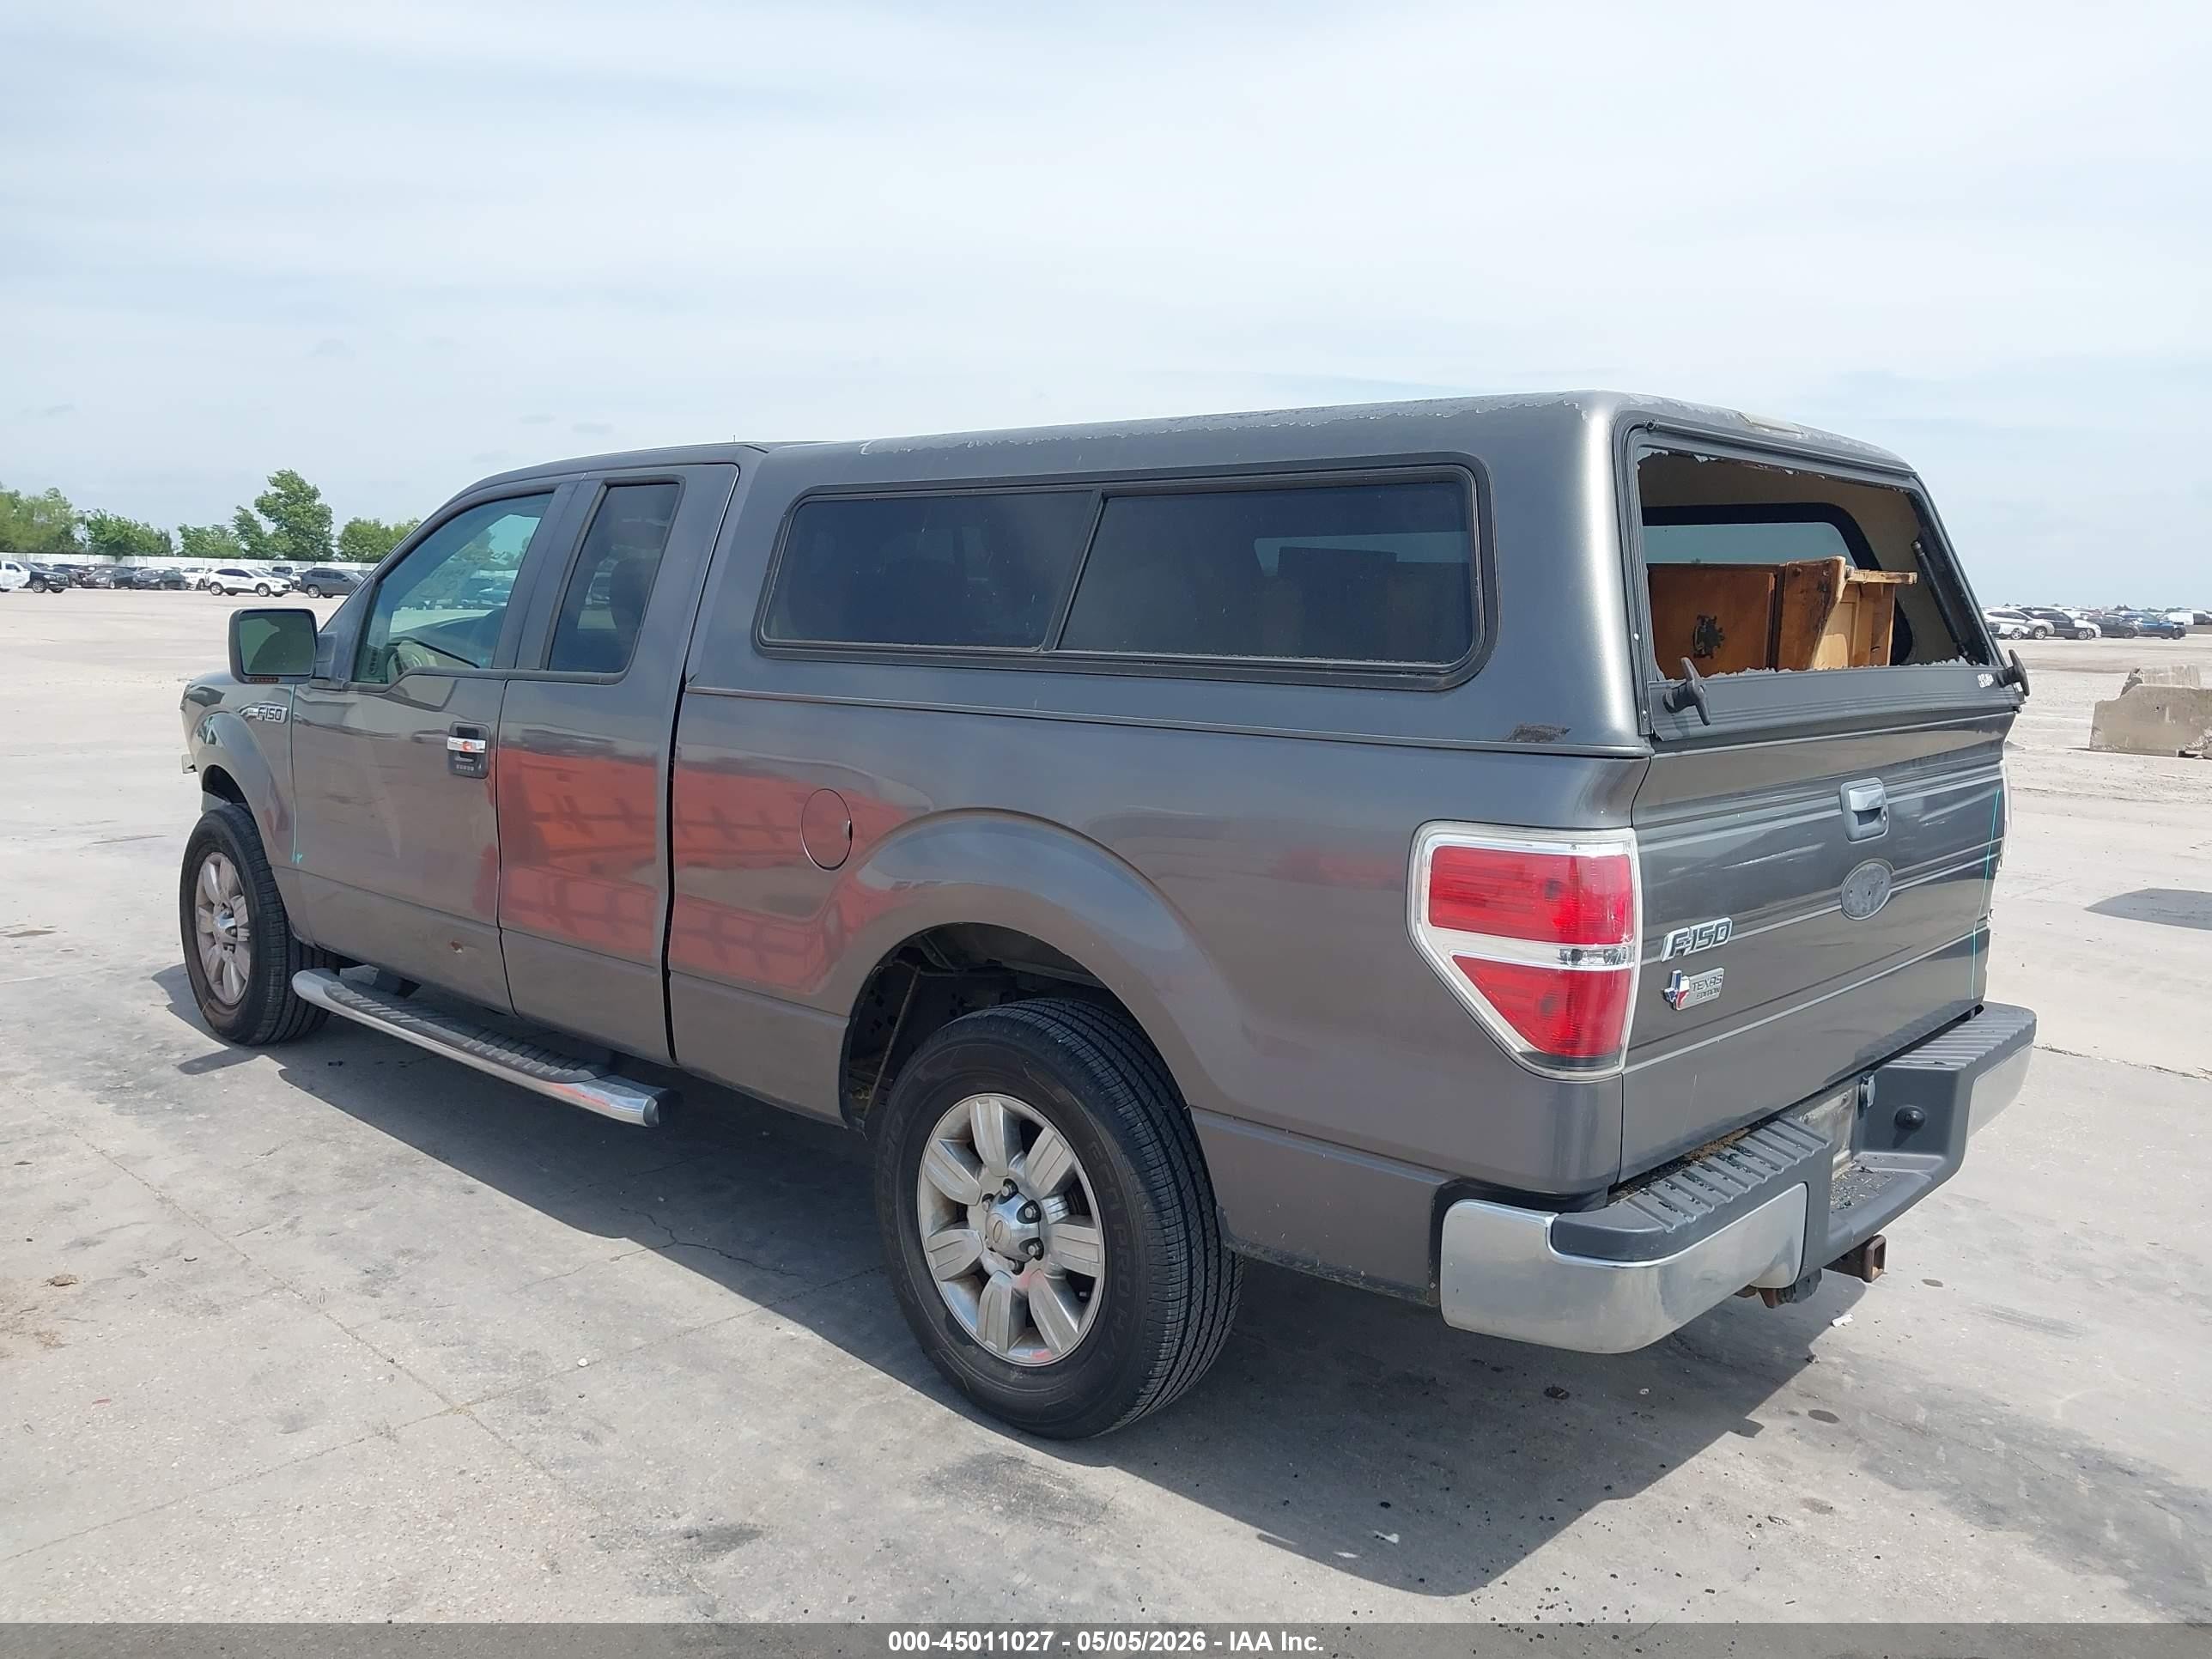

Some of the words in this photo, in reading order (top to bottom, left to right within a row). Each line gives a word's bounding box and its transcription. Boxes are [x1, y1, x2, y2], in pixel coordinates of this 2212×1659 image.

[1666, 918, 1732, 960] F-150
[1692, 974, 1723, 992] TEXAS
[1696, 988, 1720, 1000] EDITION
